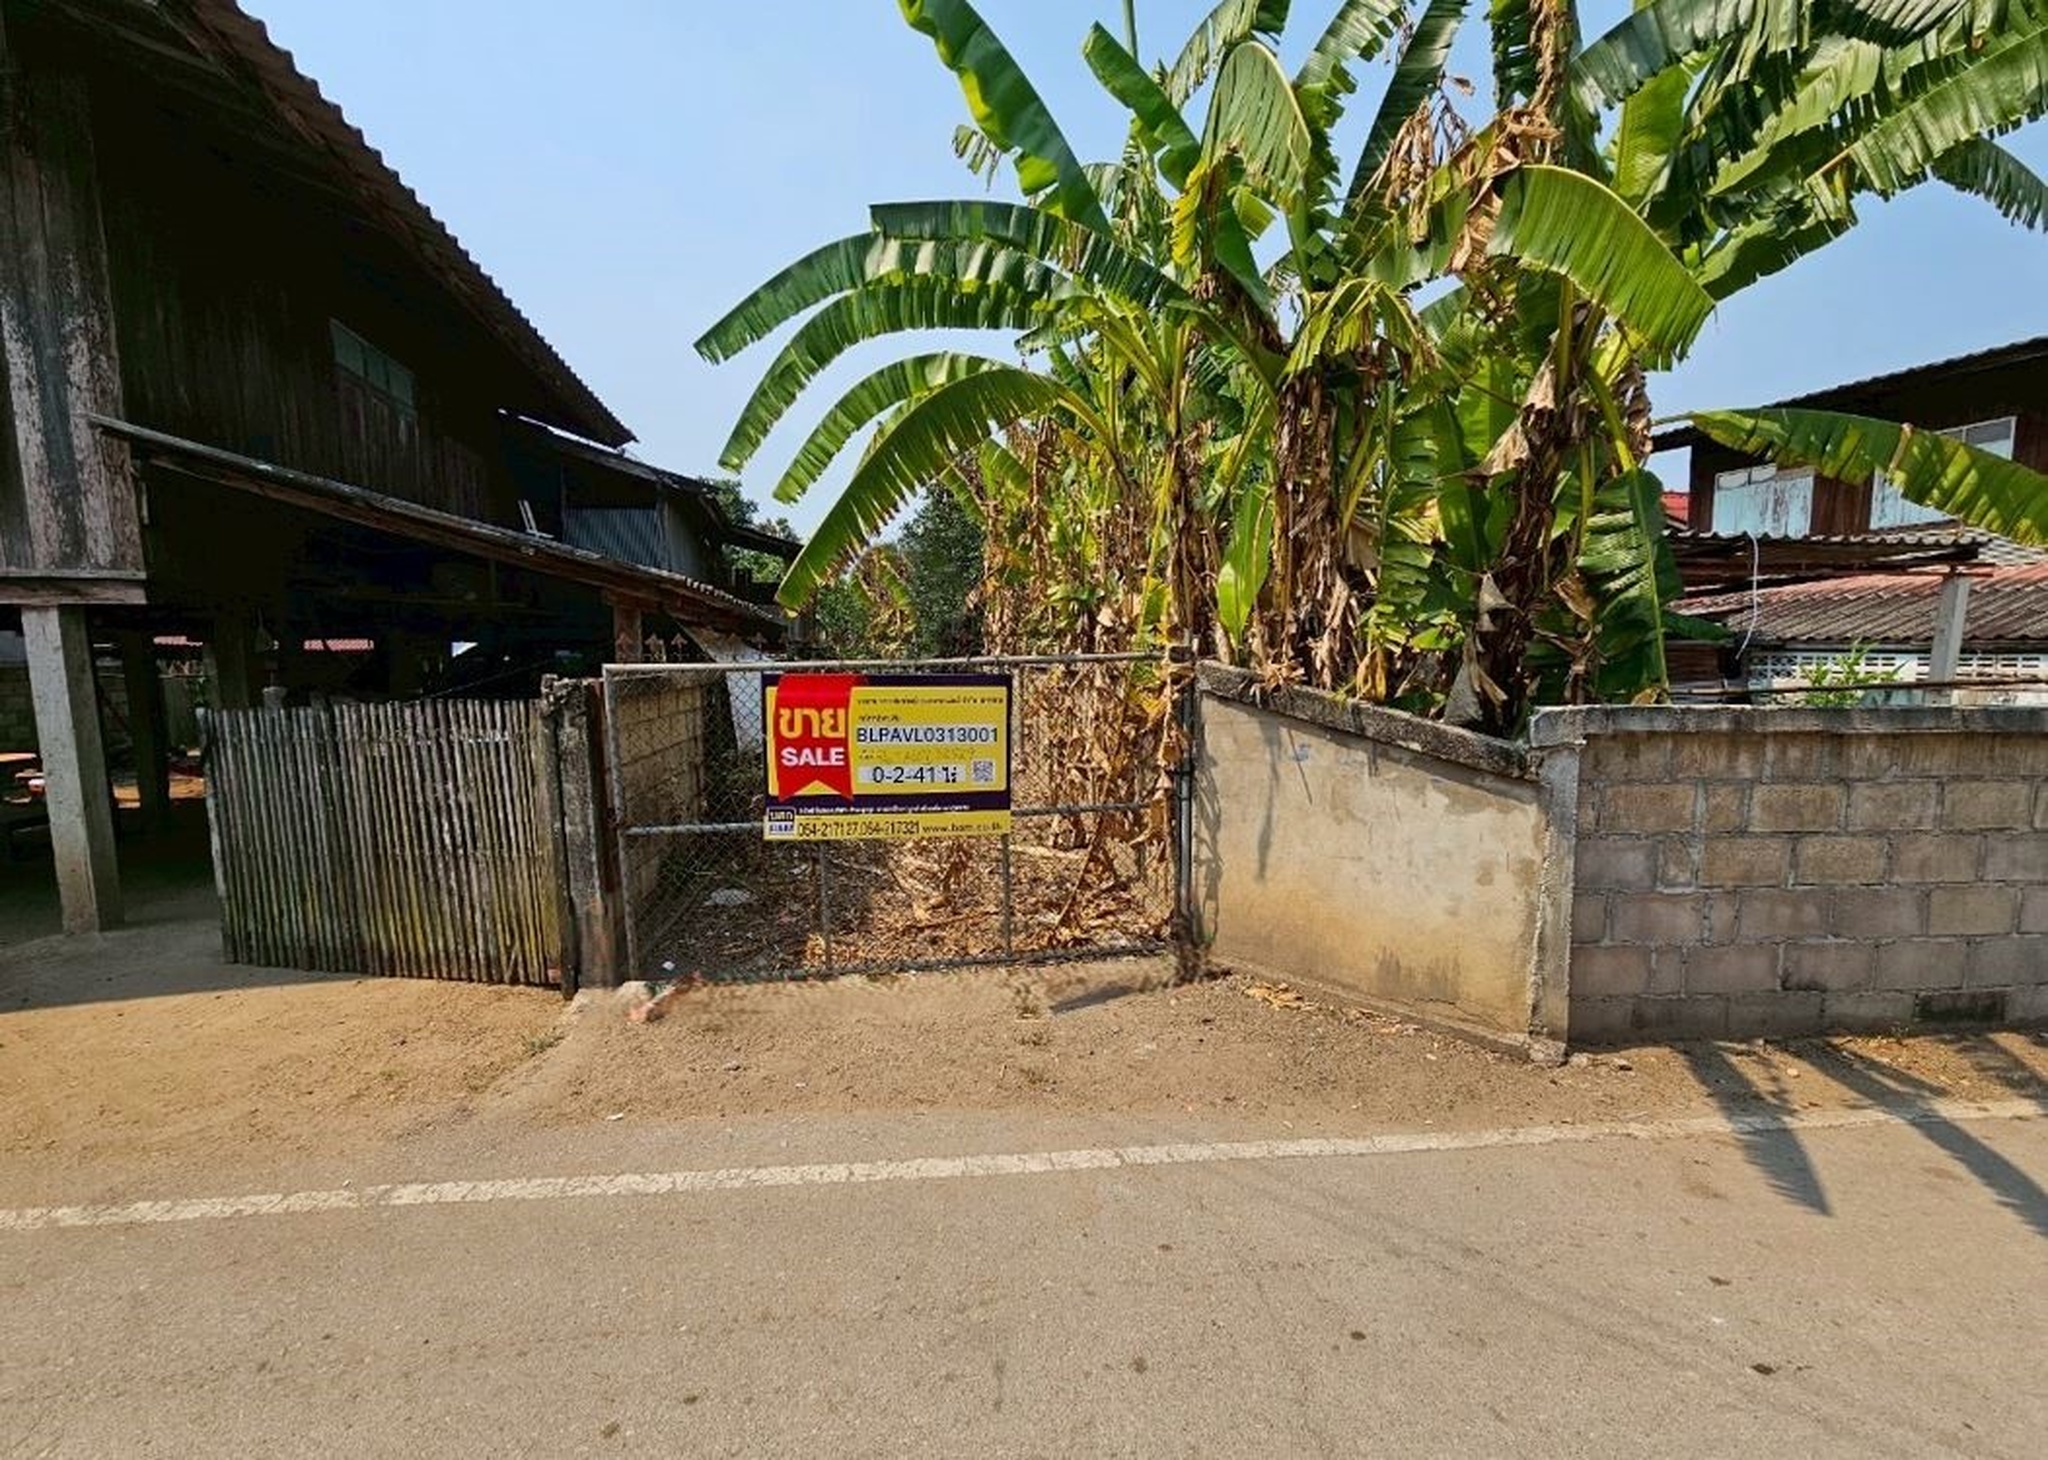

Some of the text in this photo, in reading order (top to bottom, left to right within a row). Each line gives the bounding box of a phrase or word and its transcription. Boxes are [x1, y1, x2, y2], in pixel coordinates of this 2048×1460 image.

[779, 708, 846, 739] ขาย
[856, 727, 998, 743] BLPAVL0313001
[781, 746, 846, 767] SALE
[872, 766, 935, 784] 0-2-41
